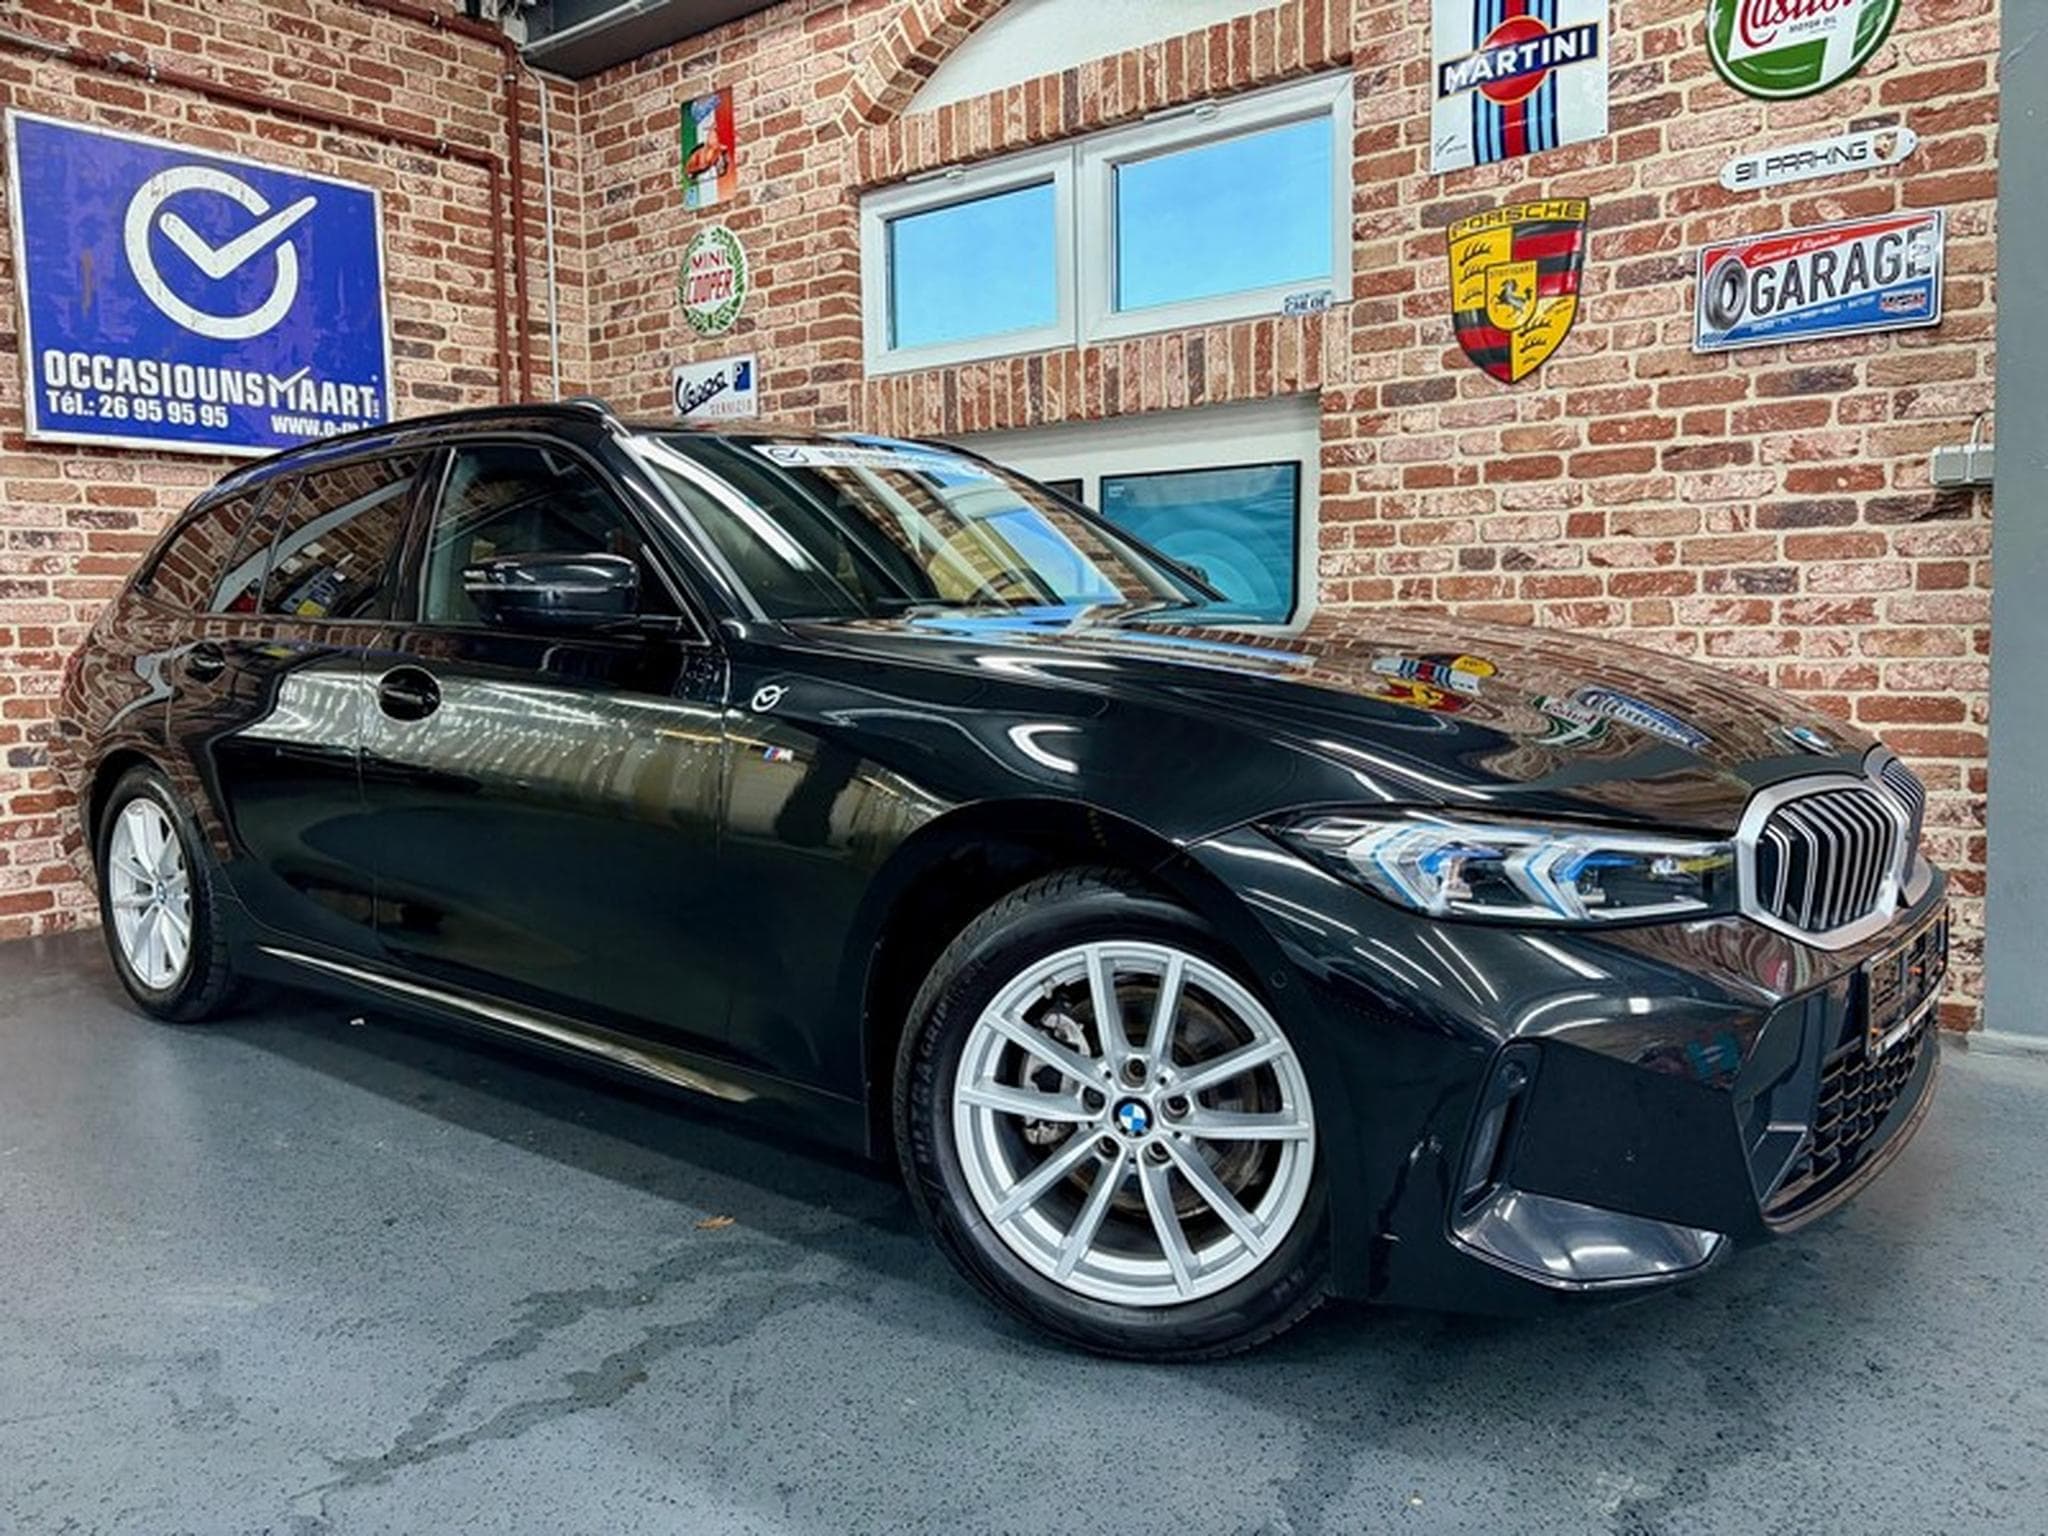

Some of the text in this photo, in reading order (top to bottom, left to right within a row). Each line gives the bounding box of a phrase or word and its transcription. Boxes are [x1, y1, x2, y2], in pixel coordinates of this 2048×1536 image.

[1445, 28, 1591, 94] MARTINI
[1766, 140, 1867, 177] PARKING
[1451, 201, 1583, 238] PORSCHE
[691, 249, 726, 269] MINI
[1749, 222, 1934, 318] GARAGE
[686, 268, 733, 305] COOPER
[43, 349, 375, 419] OCCASIOUNSMAART
[675, 370, 728, 416] Vespa
[46, 389, 230, 429] Tél.: 26 95 95 95
